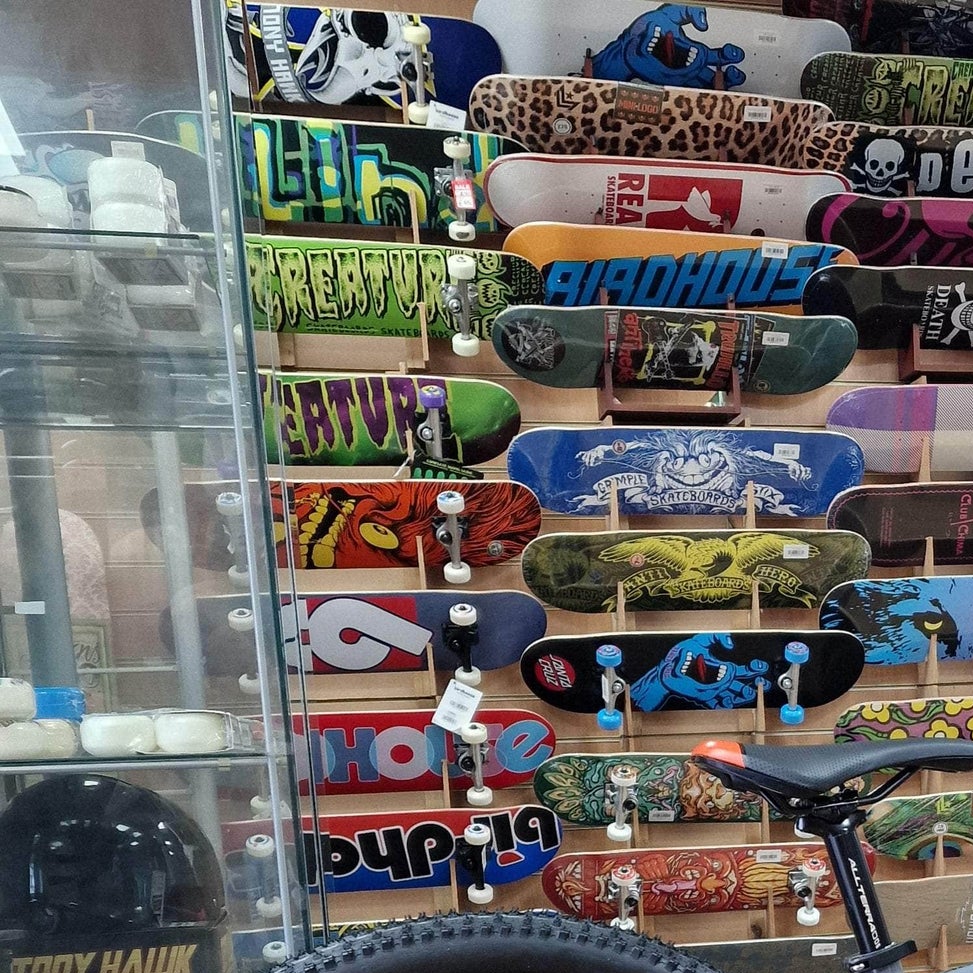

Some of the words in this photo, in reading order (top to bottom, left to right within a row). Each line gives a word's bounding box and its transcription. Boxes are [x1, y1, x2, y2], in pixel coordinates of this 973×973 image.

[605, 175, 617, 225] SKATEBOAR
[615, 172, 646, 226] REA
[265, 245, 452, 329] CREATUR
[925, 284, 952, 341] DEATH
[380, 326, 450, 340] SKATEBARDS
[597, 474, 648, 495] GRMPLE
[650, 490, 737, 510] SKATEBOARDS
[959, 493, 972, 521] CLUB
[623, 568, 666, 592] ANTI
[671, 577, 751, 594] SKATEBOARDS
[758, 566, 799, 588] HERO
[538, 657, 558, 688] CRUZ
